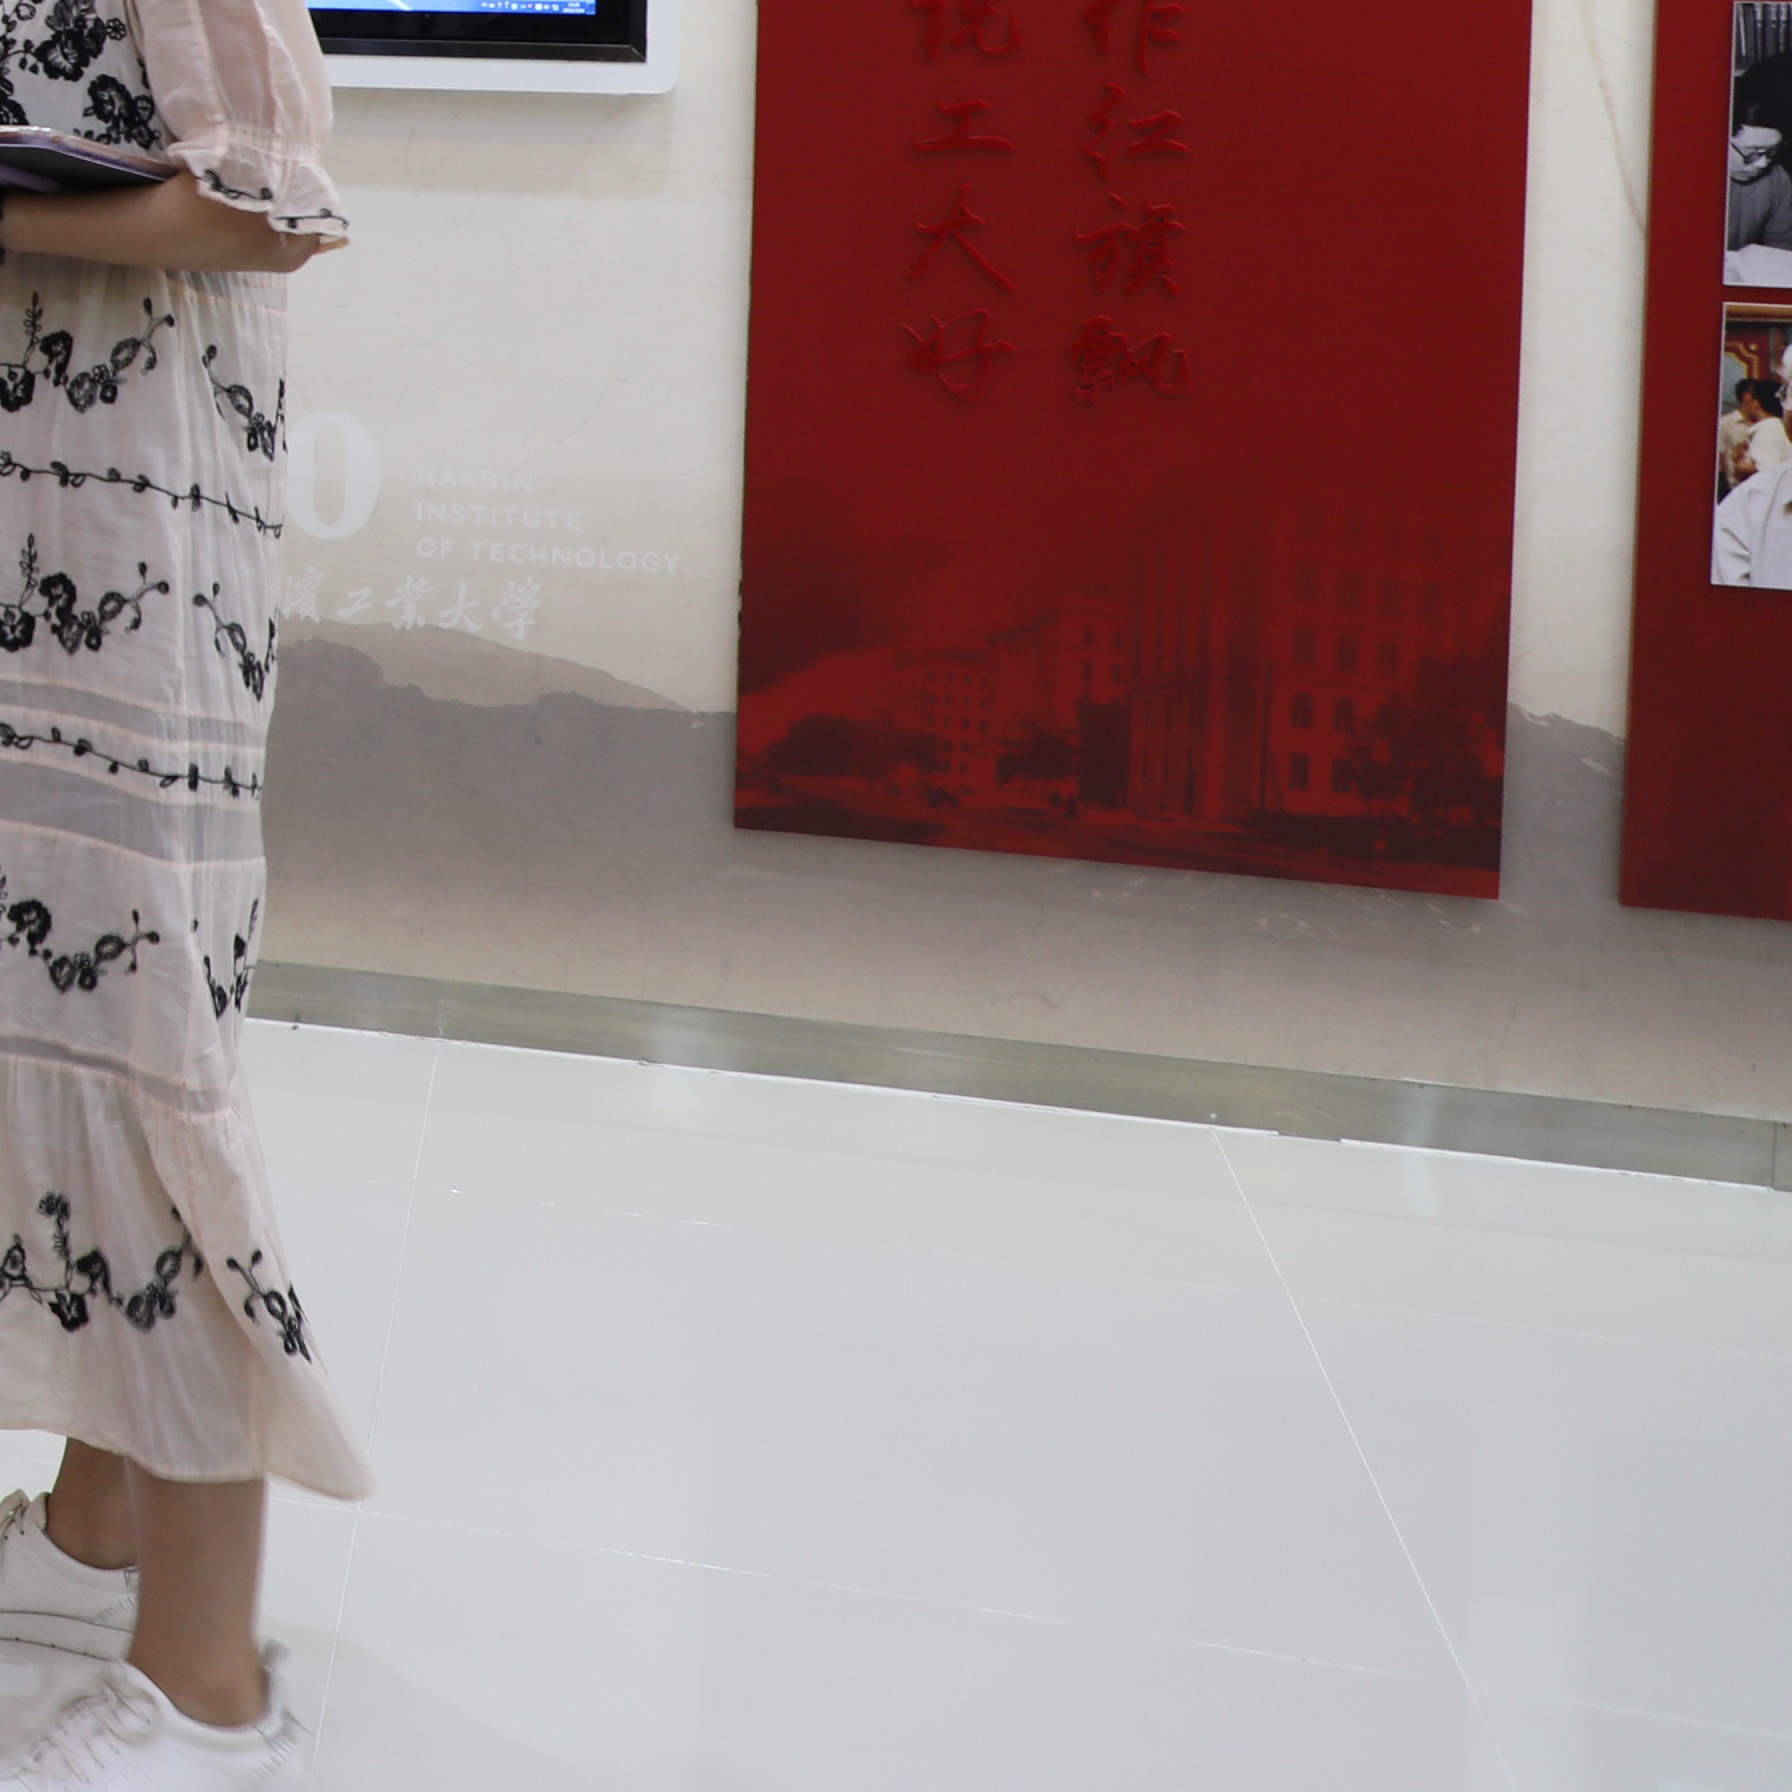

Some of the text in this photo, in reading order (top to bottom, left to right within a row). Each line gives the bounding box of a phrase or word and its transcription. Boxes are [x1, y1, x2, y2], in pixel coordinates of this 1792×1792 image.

[417, 467, 535, 492] HARBIN
[416, 502, 581, 533] INSTITUTE
[417, 539, 680, 574] OF TECHNOLOGY
